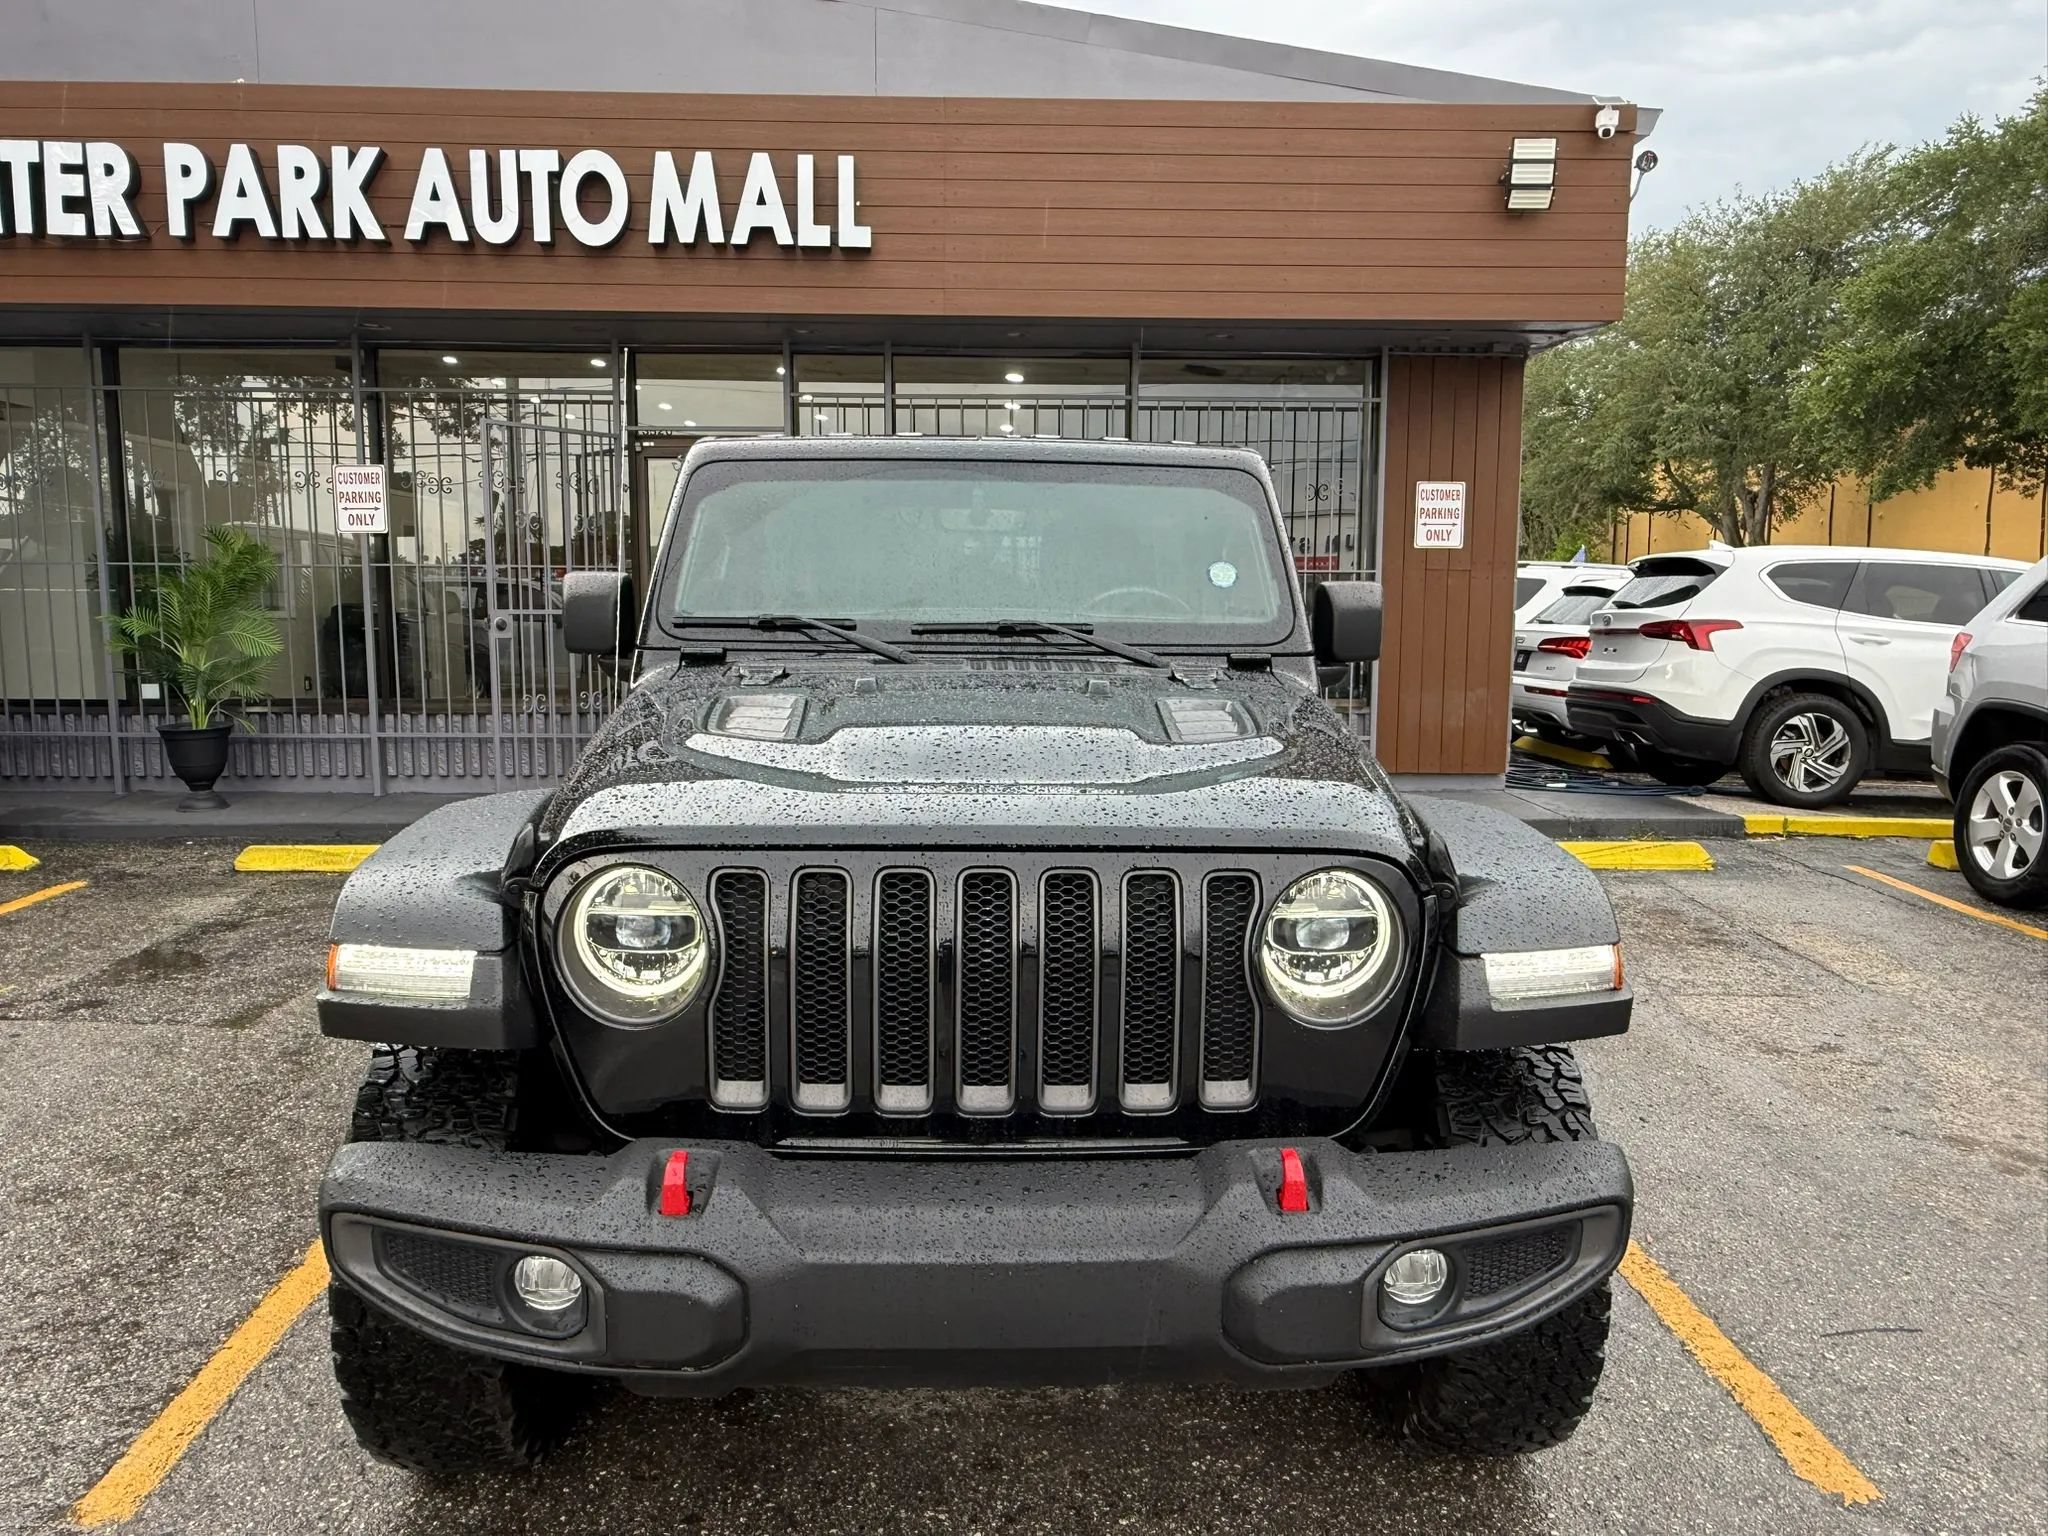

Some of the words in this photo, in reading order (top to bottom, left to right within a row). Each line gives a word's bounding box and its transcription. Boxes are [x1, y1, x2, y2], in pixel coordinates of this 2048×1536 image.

[0, 139, 142, 236] TER
[163, 142, 388, 240] PARK
[403, 147, 629, 247] AUTO
[648, 151, 872, 248] MALL
[337, 472, 381, 485] CUSTOMER
[338, 491, 382, 504] PARKING
[1420, 489, 1461, 501] CUSTOMER
[347, 513, 375, 526] ONLY
[1419, 507, 1460, 520] PARKING
[1425, 529, 1452, 542] ONLY
